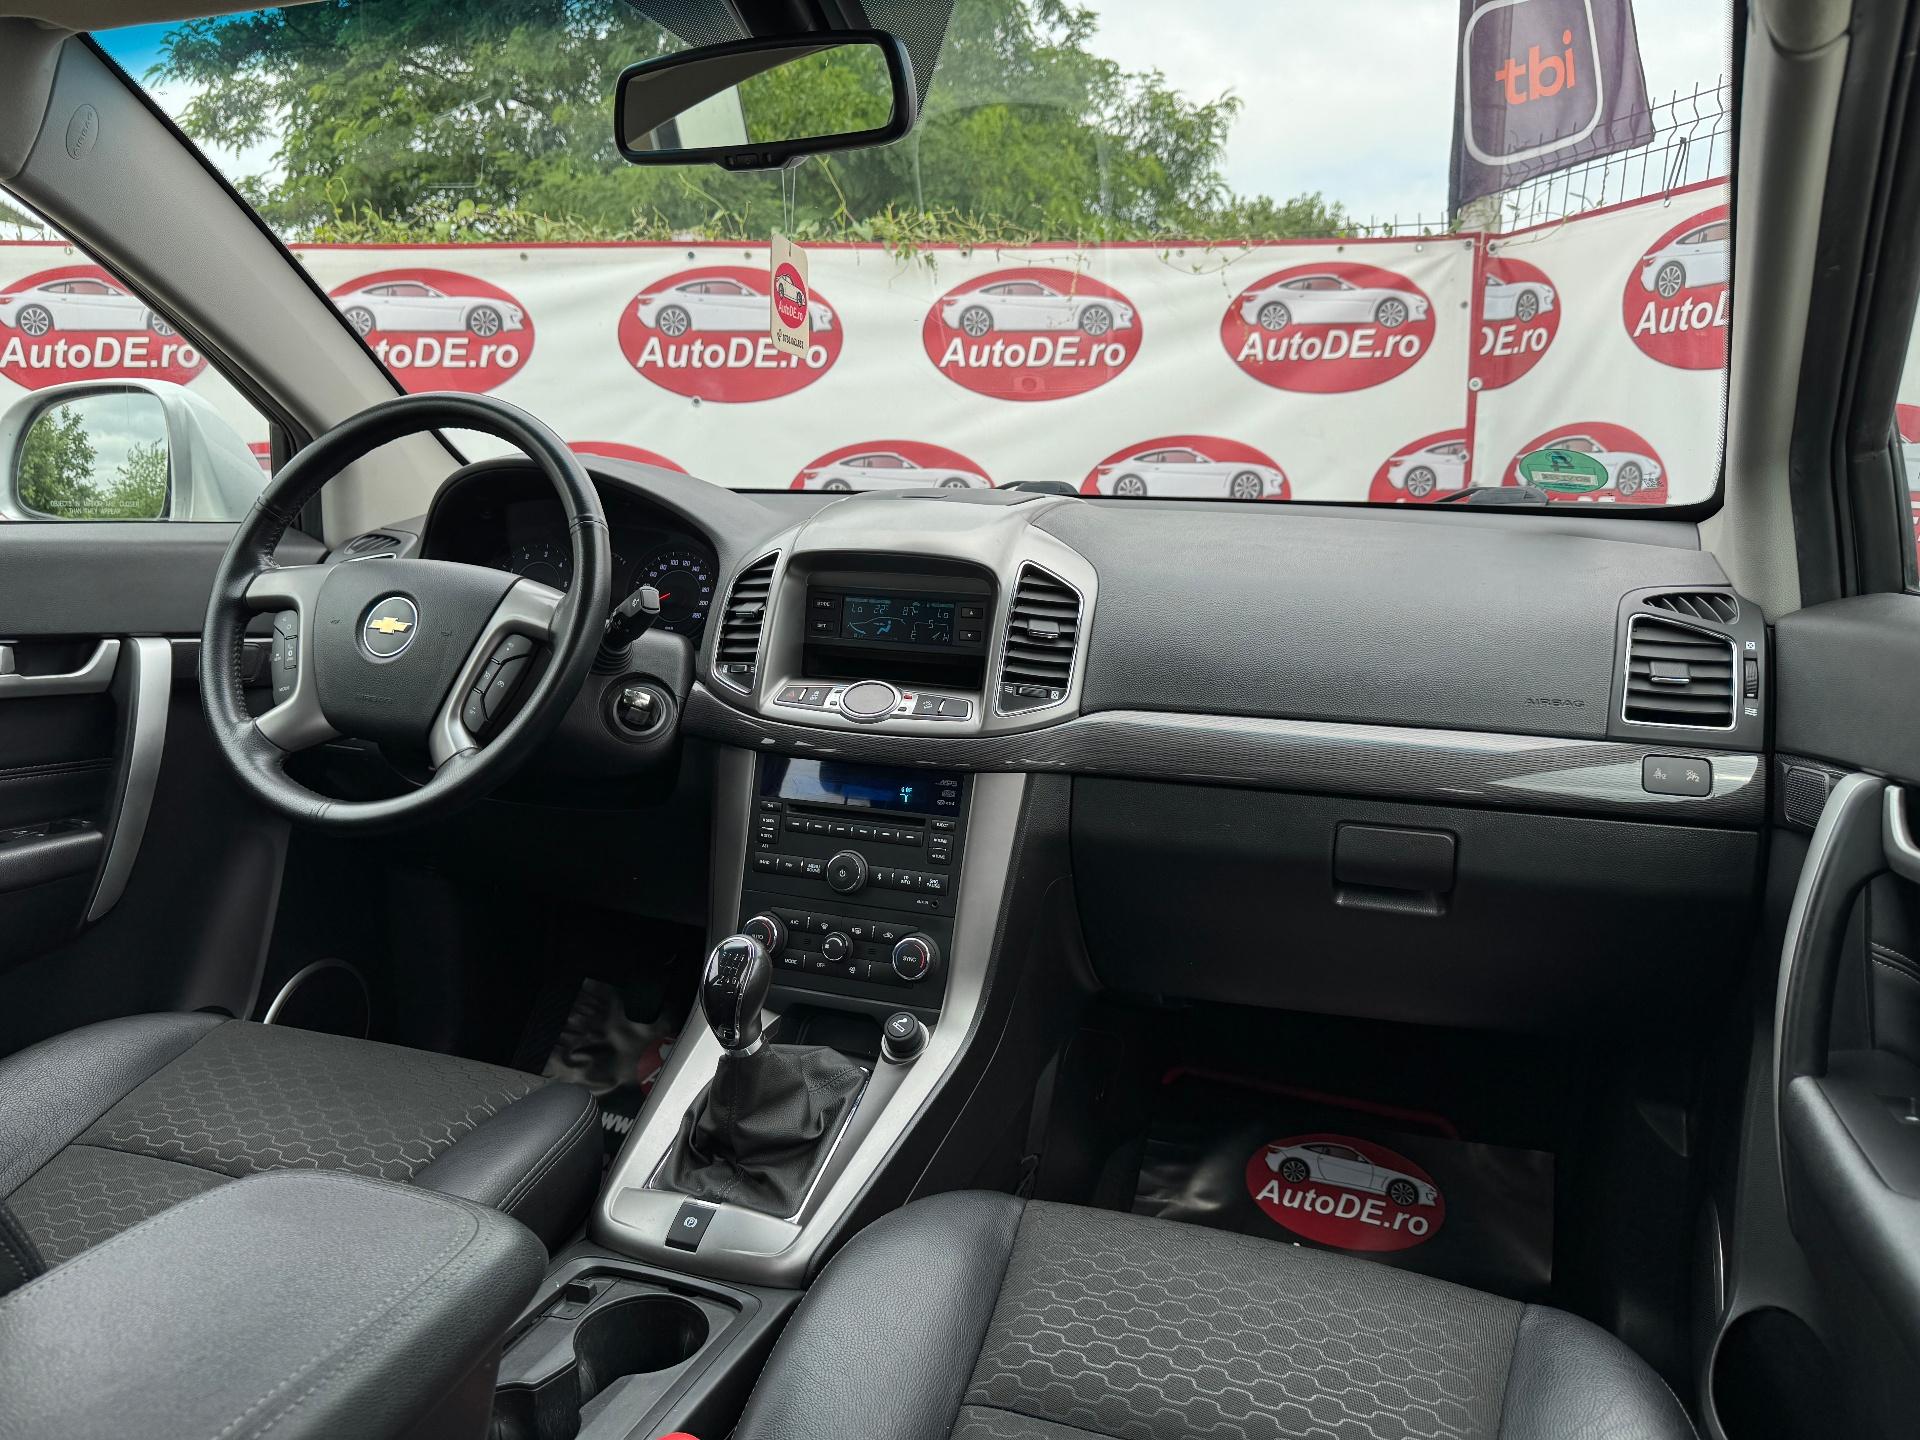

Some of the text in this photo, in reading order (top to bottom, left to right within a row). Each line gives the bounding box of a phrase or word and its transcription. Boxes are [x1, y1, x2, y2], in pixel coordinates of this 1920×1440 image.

[1495, 29, 1576, 105] tbi
[0, 336, 201, 369] AutoDE.ro
[370, 336, 519, 369] toDE.ro
[939, 336, 1127, 368] AutoDE.ro
[1236, 328, 1422, 362] AutoDE.ro
[1255, 1178, 1430, 1237] AutoDE.ro
